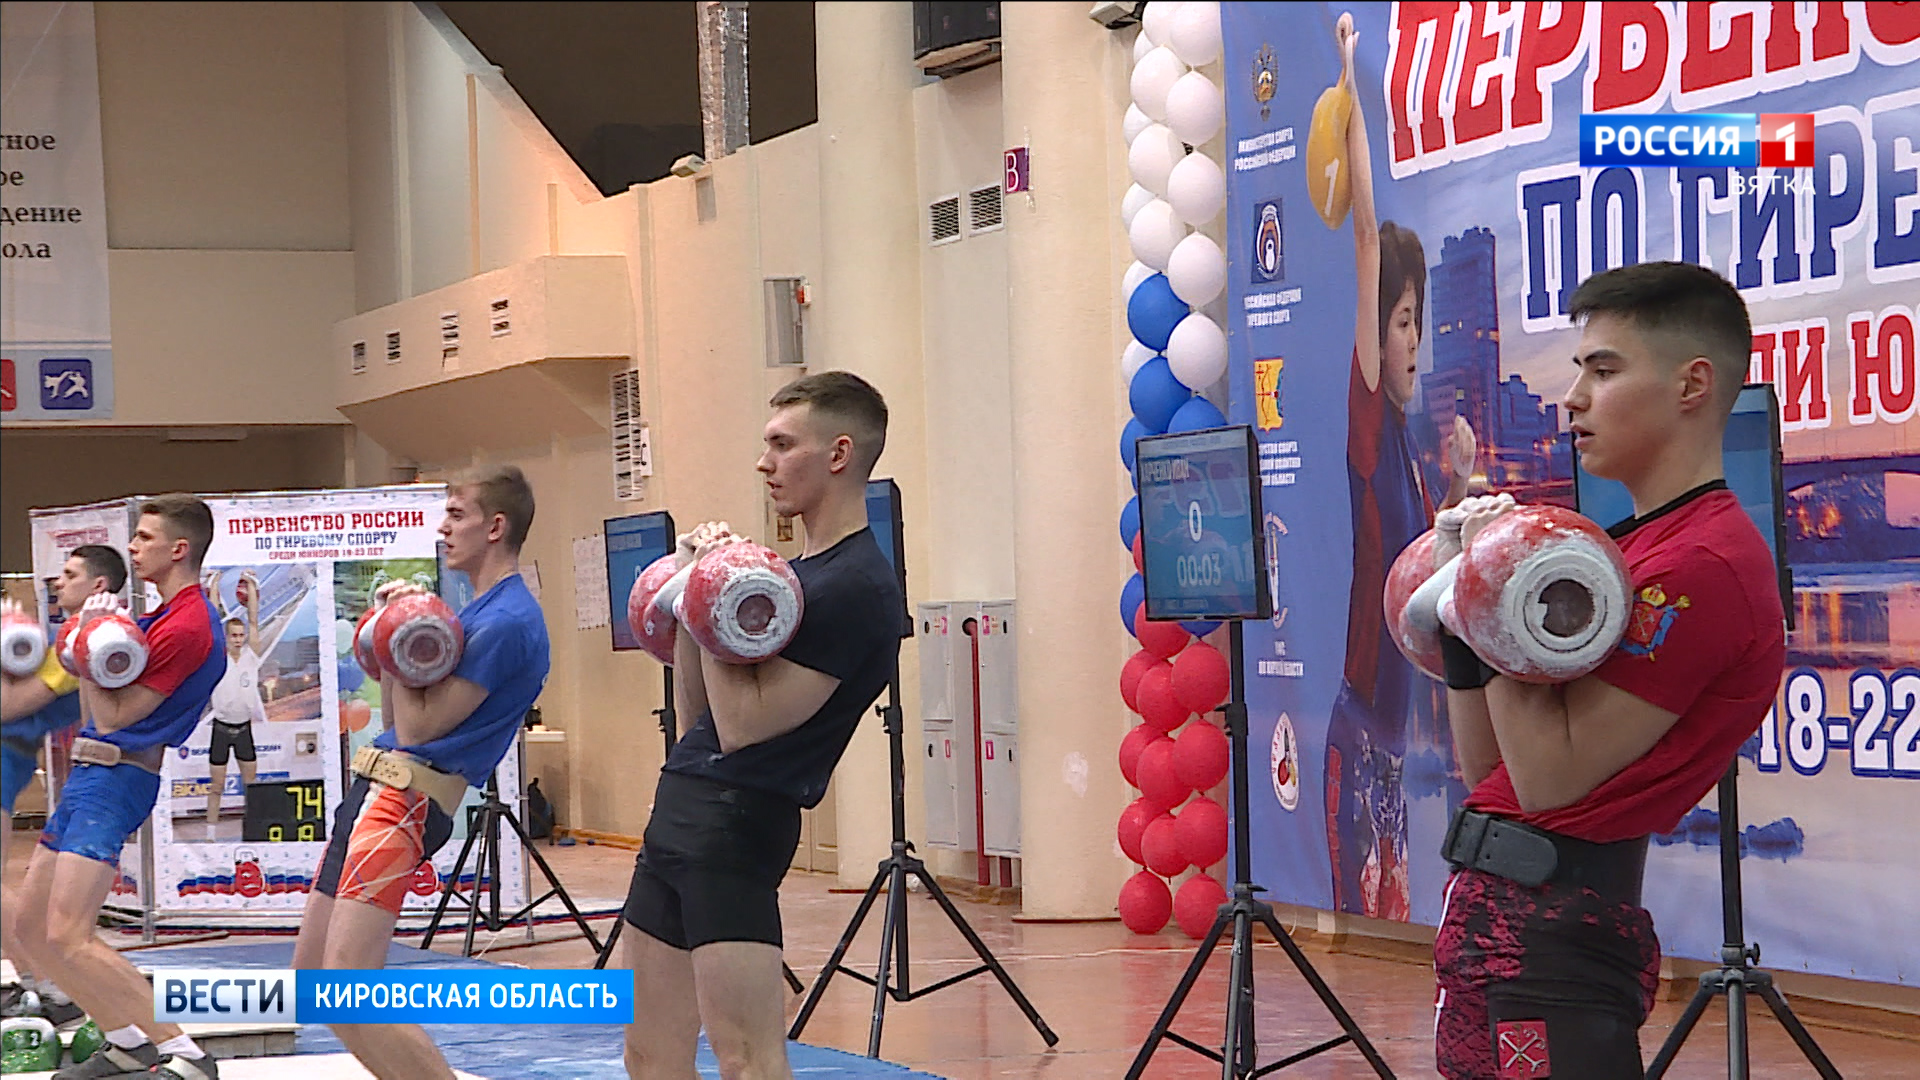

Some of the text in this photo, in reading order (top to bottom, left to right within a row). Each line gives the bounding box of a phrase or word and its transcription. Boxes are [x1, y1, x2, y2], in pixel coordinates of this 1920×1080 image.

[1324, 157, 1340, 217] 1
[228, 511, 425, 534] ПЕРВЕНСТВО РОССИИ
[255, 531, 397, 550] ПО ГИРЕВОМУ СПОРТУ
[1188, 500, 1203, 543] 0
[1757, 667, 1920, 778] 18-22
[286, 786, 323, 820] 74
